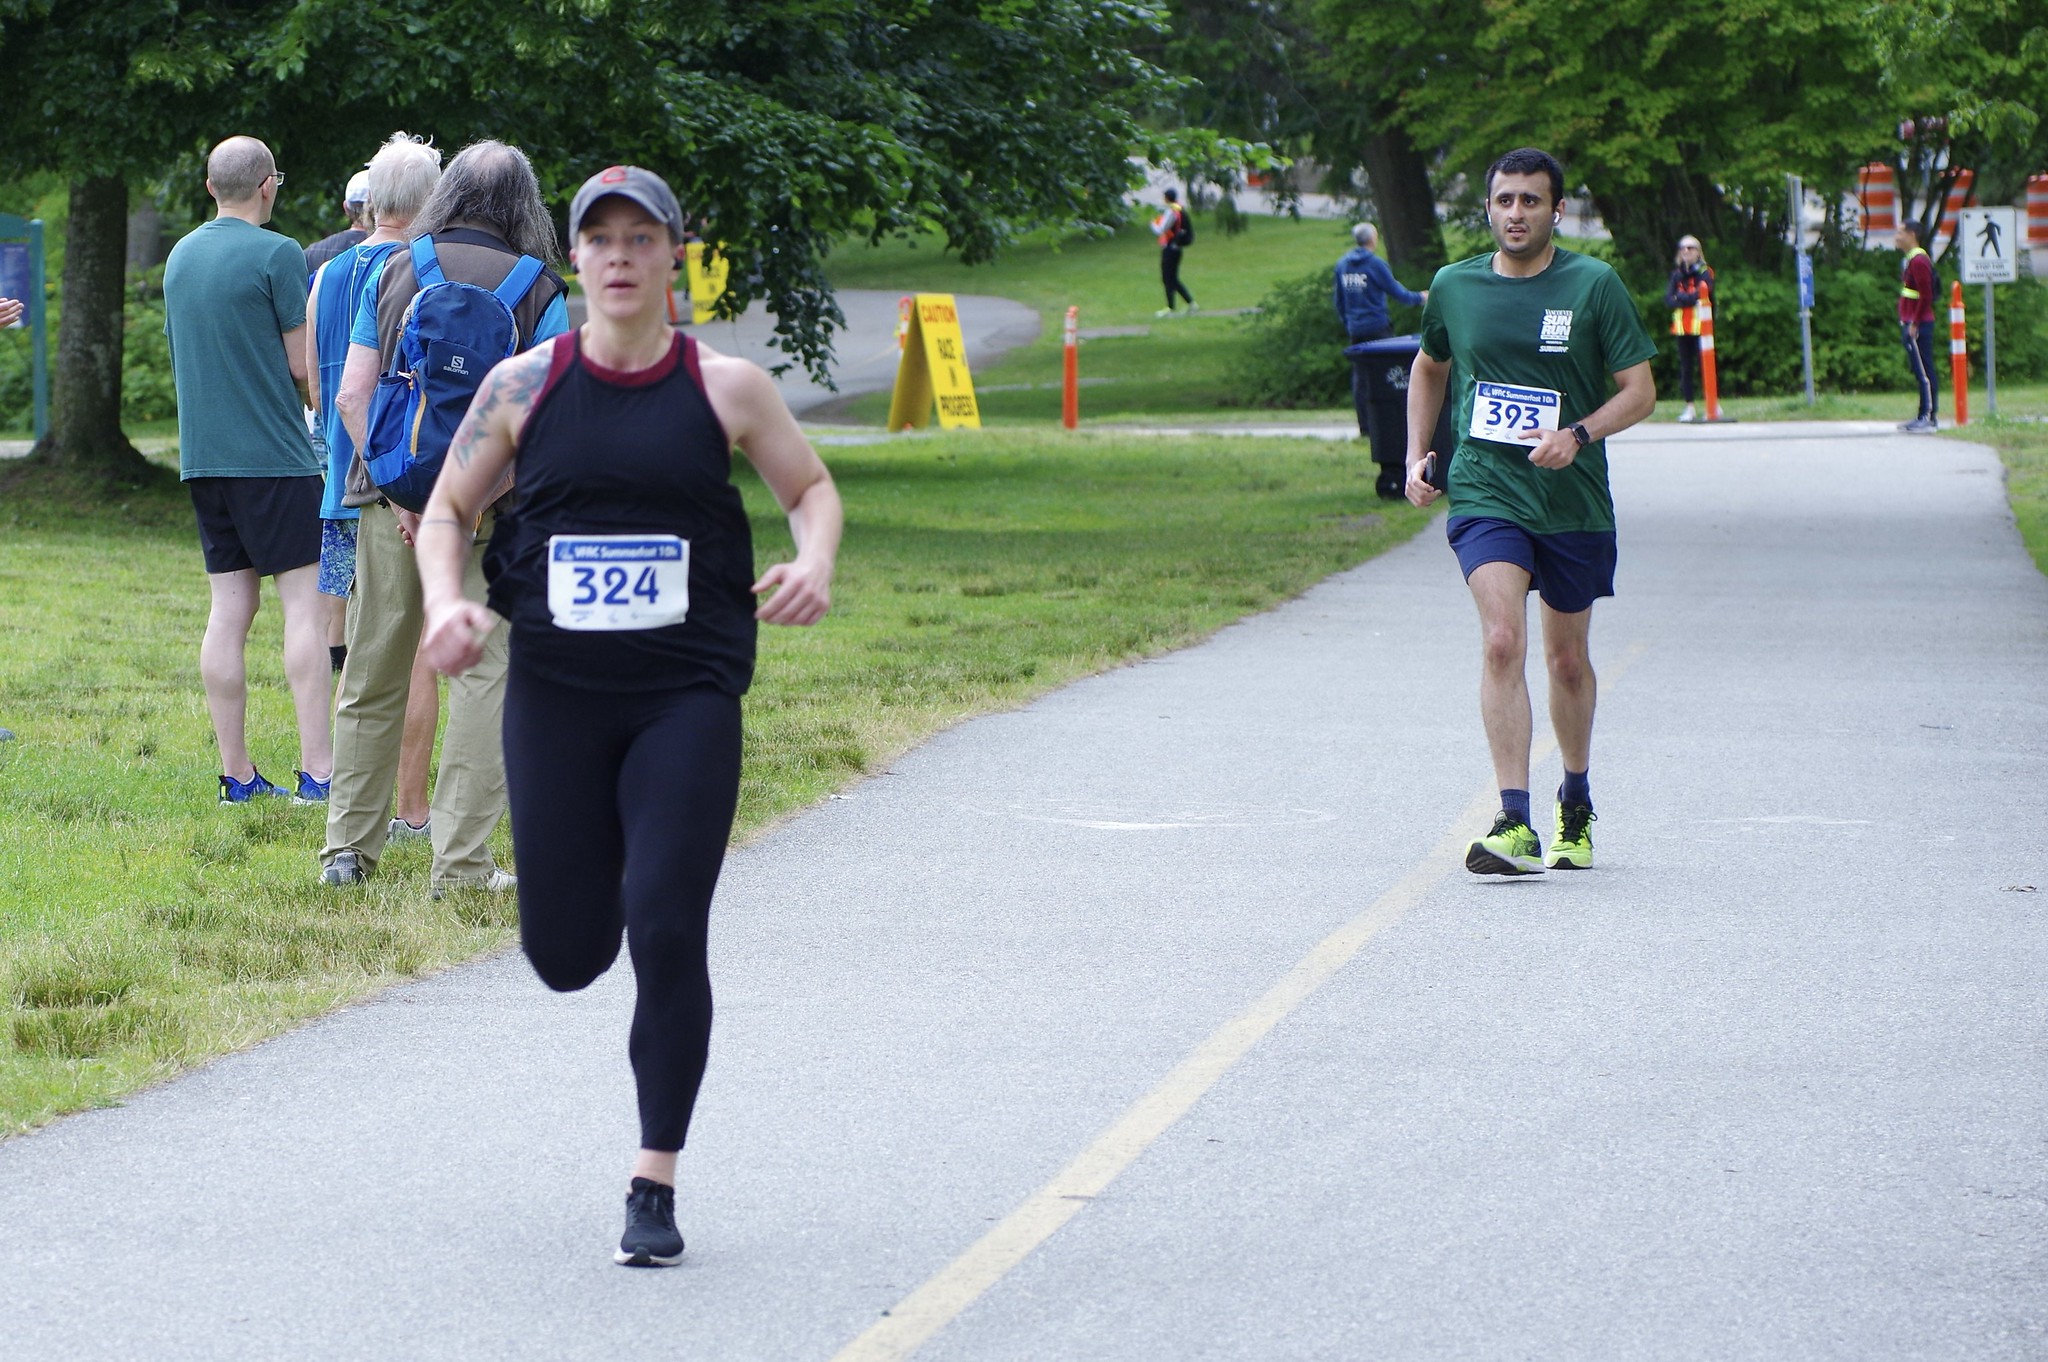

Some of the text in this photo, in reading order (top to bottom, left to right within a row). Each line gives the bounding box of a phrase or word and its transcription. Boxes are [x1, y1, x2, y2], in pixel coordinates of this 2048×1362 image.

[1341, 273, 1368, 287] VFAC
[921, 304, 957, 323] CAUTION
[1542, 315, 1572, 326] SUN
[1541, 325, 1571, 336] RUN
[937, 338, 956, 360] RACE
[940, 394, 976, 416] PROGRESS
[1486, 401, 1540, 430] 393
[573, 566, 659, 605] 324
